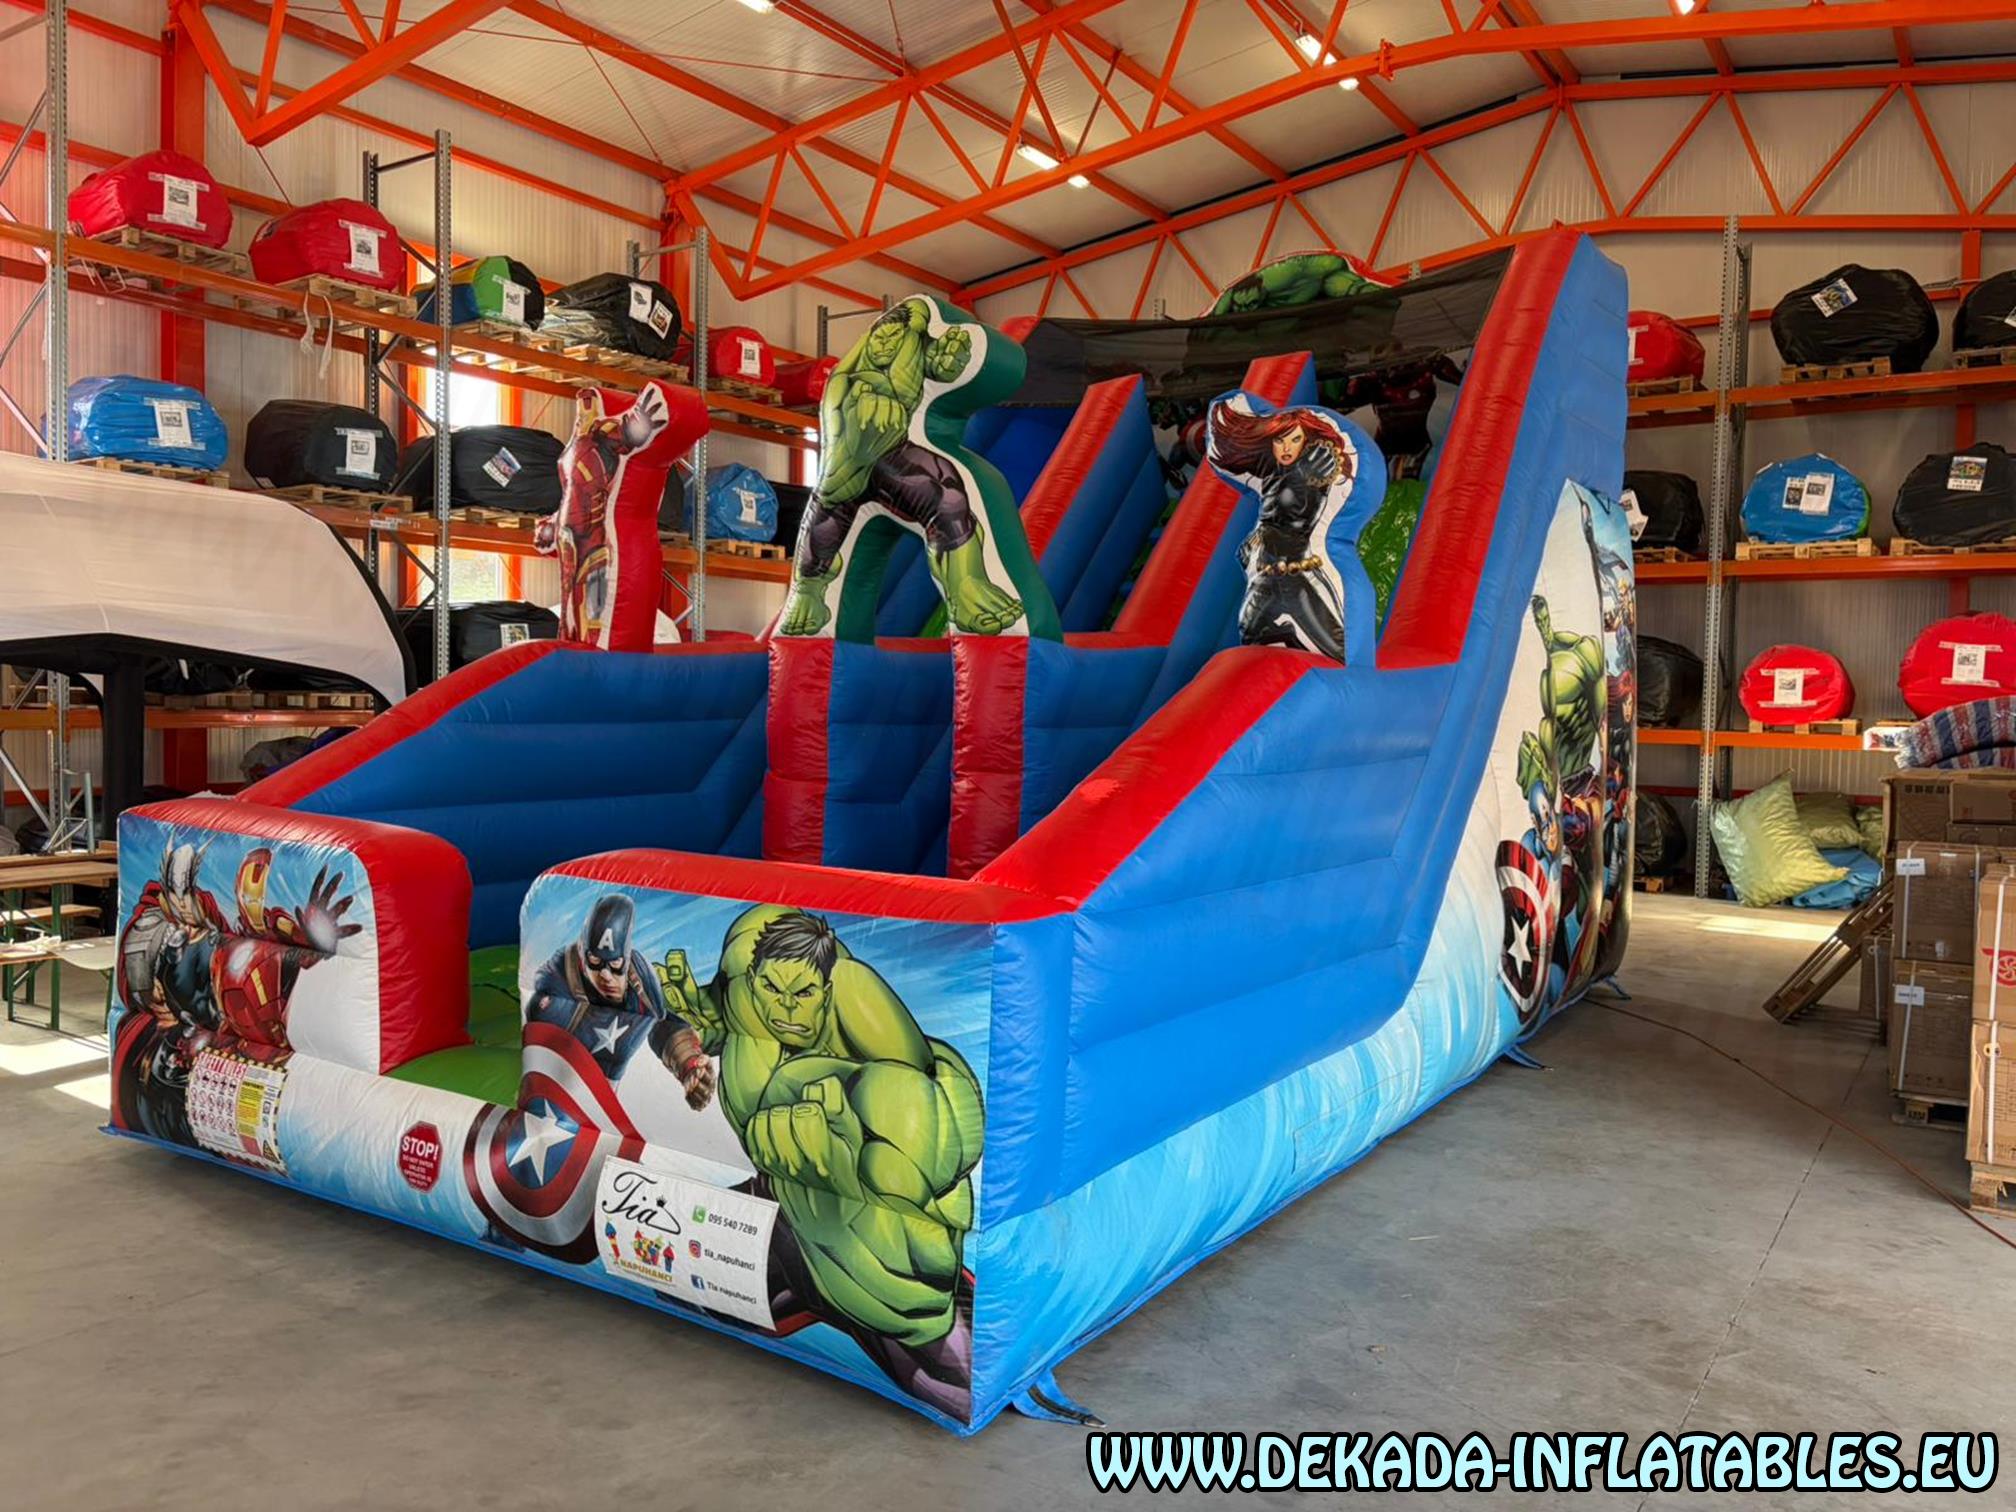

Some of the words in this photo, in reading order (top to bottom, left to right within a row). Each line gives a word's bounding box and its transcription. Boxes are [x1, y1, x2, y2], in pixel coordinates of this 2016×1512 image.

[598, 928, 615, 951] A
[402, 1136, 439, 1160] STOP!
[708, 1213, 722, 1225] 095
[723, 1218, 738, 1230] 540
